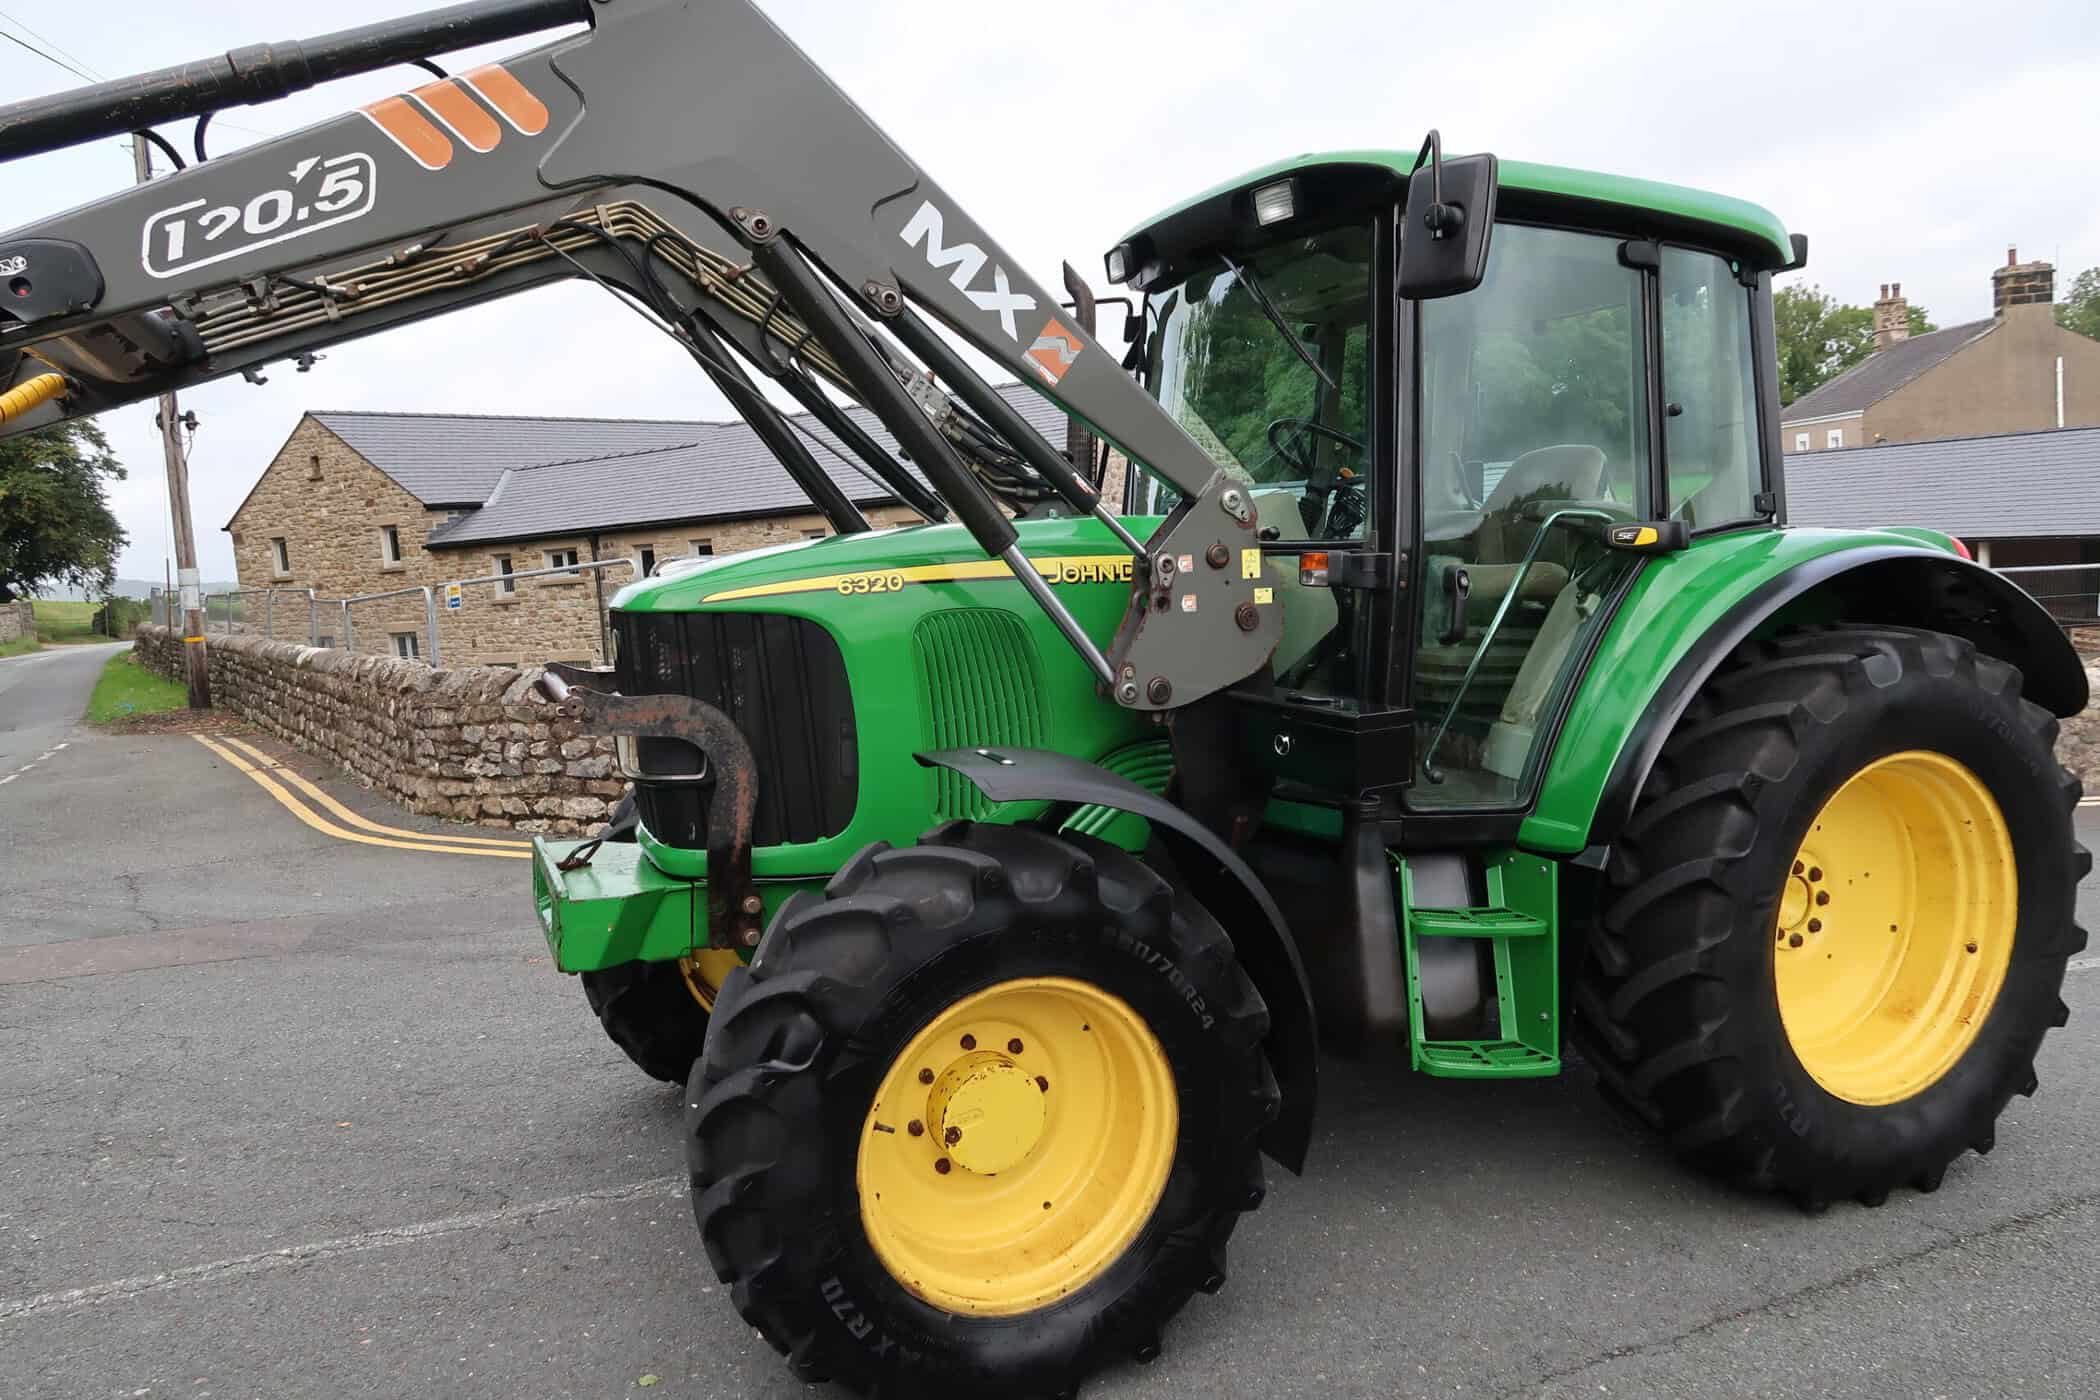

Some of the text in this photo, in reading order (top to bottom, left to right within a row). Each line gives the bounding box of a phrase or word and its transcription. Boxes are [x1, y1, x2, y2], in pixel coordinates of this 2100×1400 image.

[899, 199, 1038, 343] MX
[1047, 560, 1118, 584] JOHN
[837, 574, 905, 596] 6320
